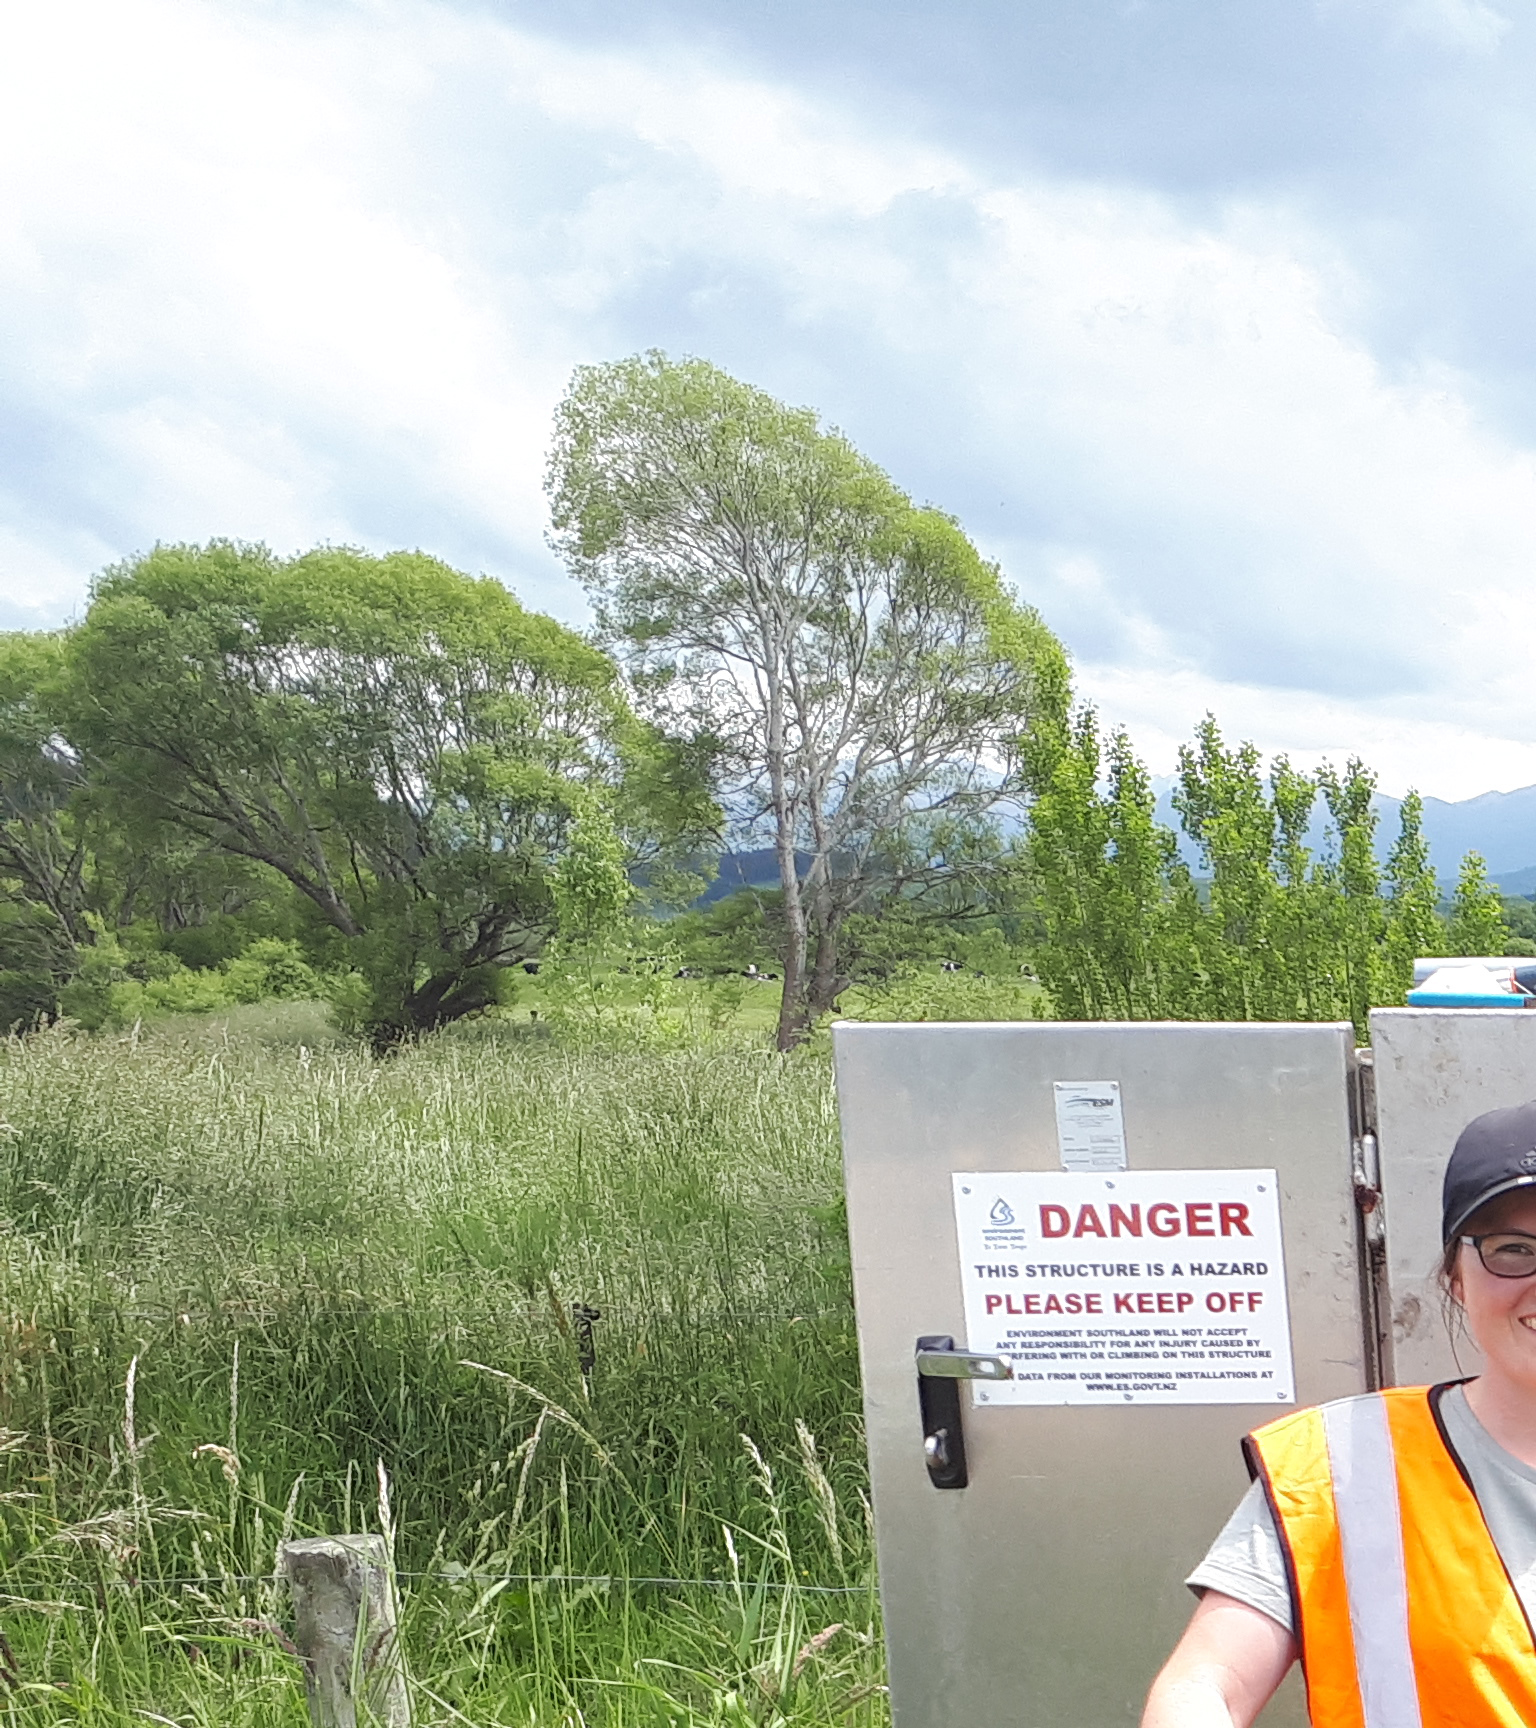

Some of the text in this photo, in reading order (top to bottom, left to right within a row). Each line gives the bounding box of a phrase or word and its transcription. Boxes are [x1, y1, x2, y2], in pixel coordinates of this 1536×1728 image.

[1039, 1202, 1254, 1238] DANGER
[974, 1262, 1269, 1278] THIS STRUCTURE IS A HAZARD
[985, 1291, 1264, 1315] PLEASE KEEP OFF
[1006, 1328, 1248, 1338] ENVIRONMENT SOUTHLAND WILL NOT ACCEPT
[996, 1339, 1261, 1349] ANY RESPONSIBILITY FOR ANY INJURY CAUSED BY
[1059, 1351, 1087, 1360] WITH
[1090, 1351, 1105, 1360] OR
[1107, 1351, 1159, 1360] CLIMBING
[1162, 1350, 1178, 1359] ON
[1180, 1350, 1206, 1359] THIS
[1208, 1350, 1272, 1359] STRUCTURE
[1018, 1372, 1044, 1381] DATA
[1046, 1372, 1077, 1380] FROM
[1079, 1372, 1102, 1380] OUR
[1104, 1371, 1172, 1380] MONITORING
[1175, 1370, 1258, 1379] INSTALLATIONS
[1260, 1370, 1274, 1379] AT
